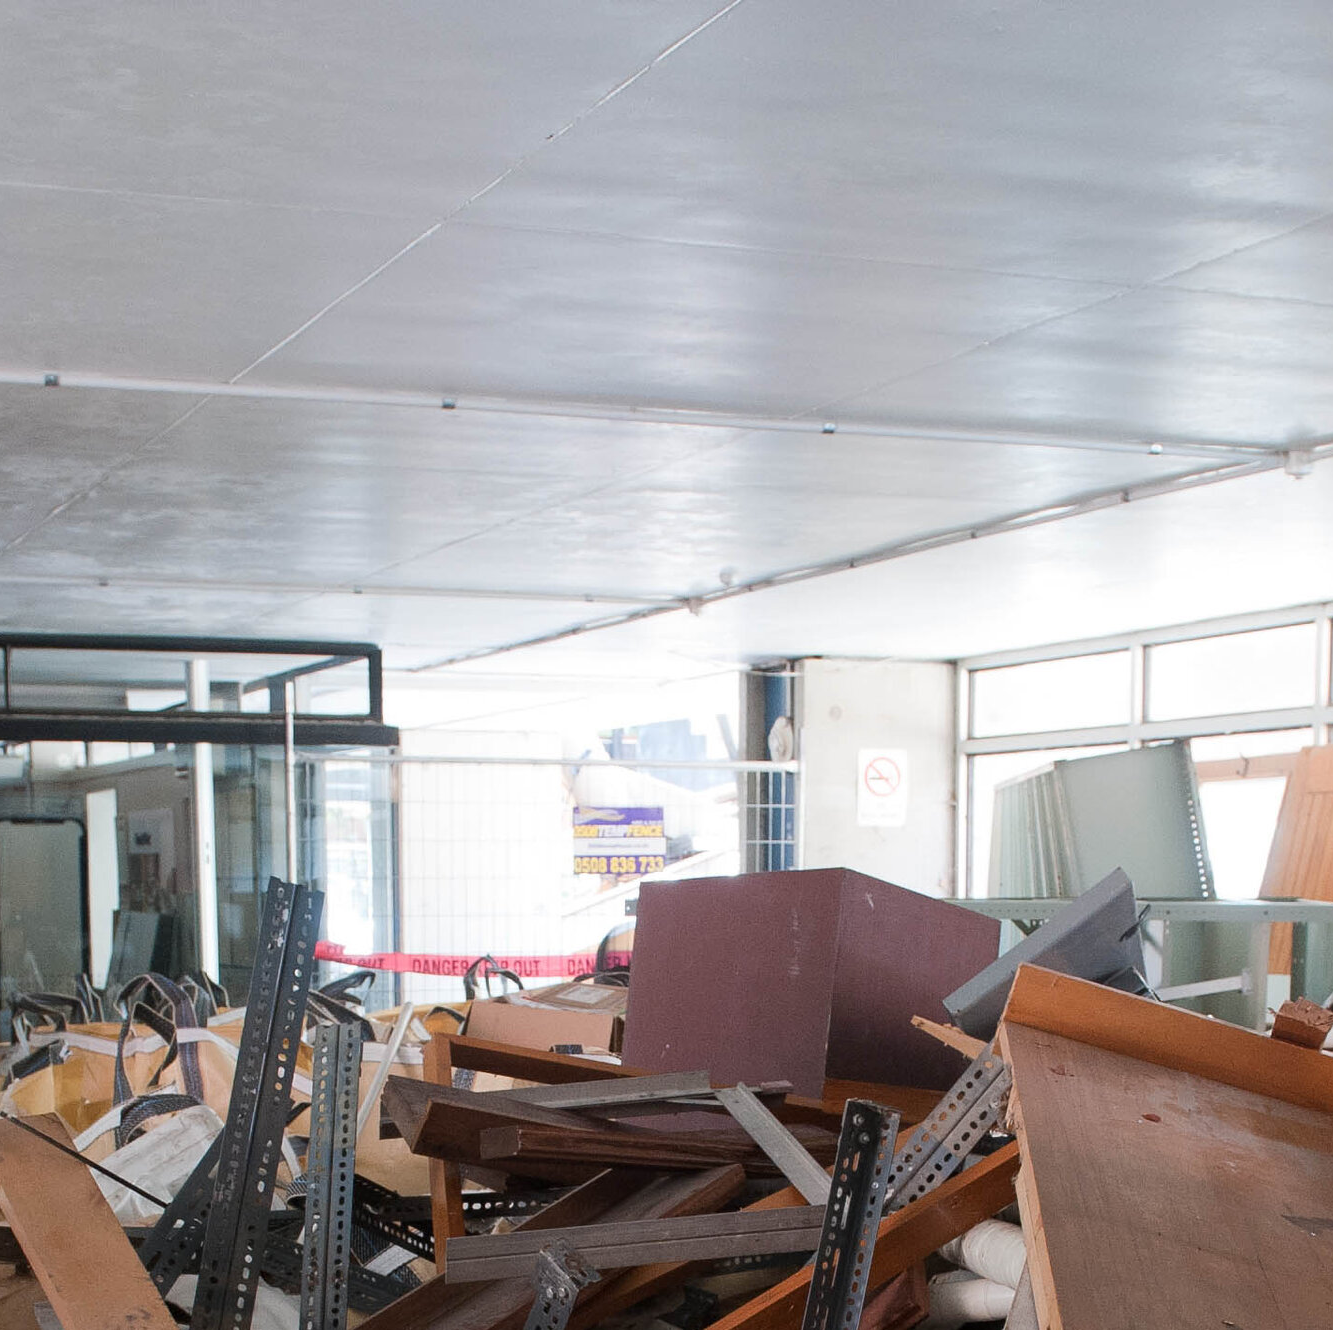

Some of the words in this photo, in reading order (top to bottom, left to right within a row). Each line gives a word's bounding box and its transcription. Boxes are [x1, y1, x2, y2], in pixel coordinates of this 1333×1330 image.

[574, 857, 607, 873] 0508
[610, 857, 636, 873] 836
[639, 856, 664, 872] 733
[412, 959, 469, 974] DANGER
[514, 960, 541, 976] OUT
[568, 956, 621, 975] DANER
